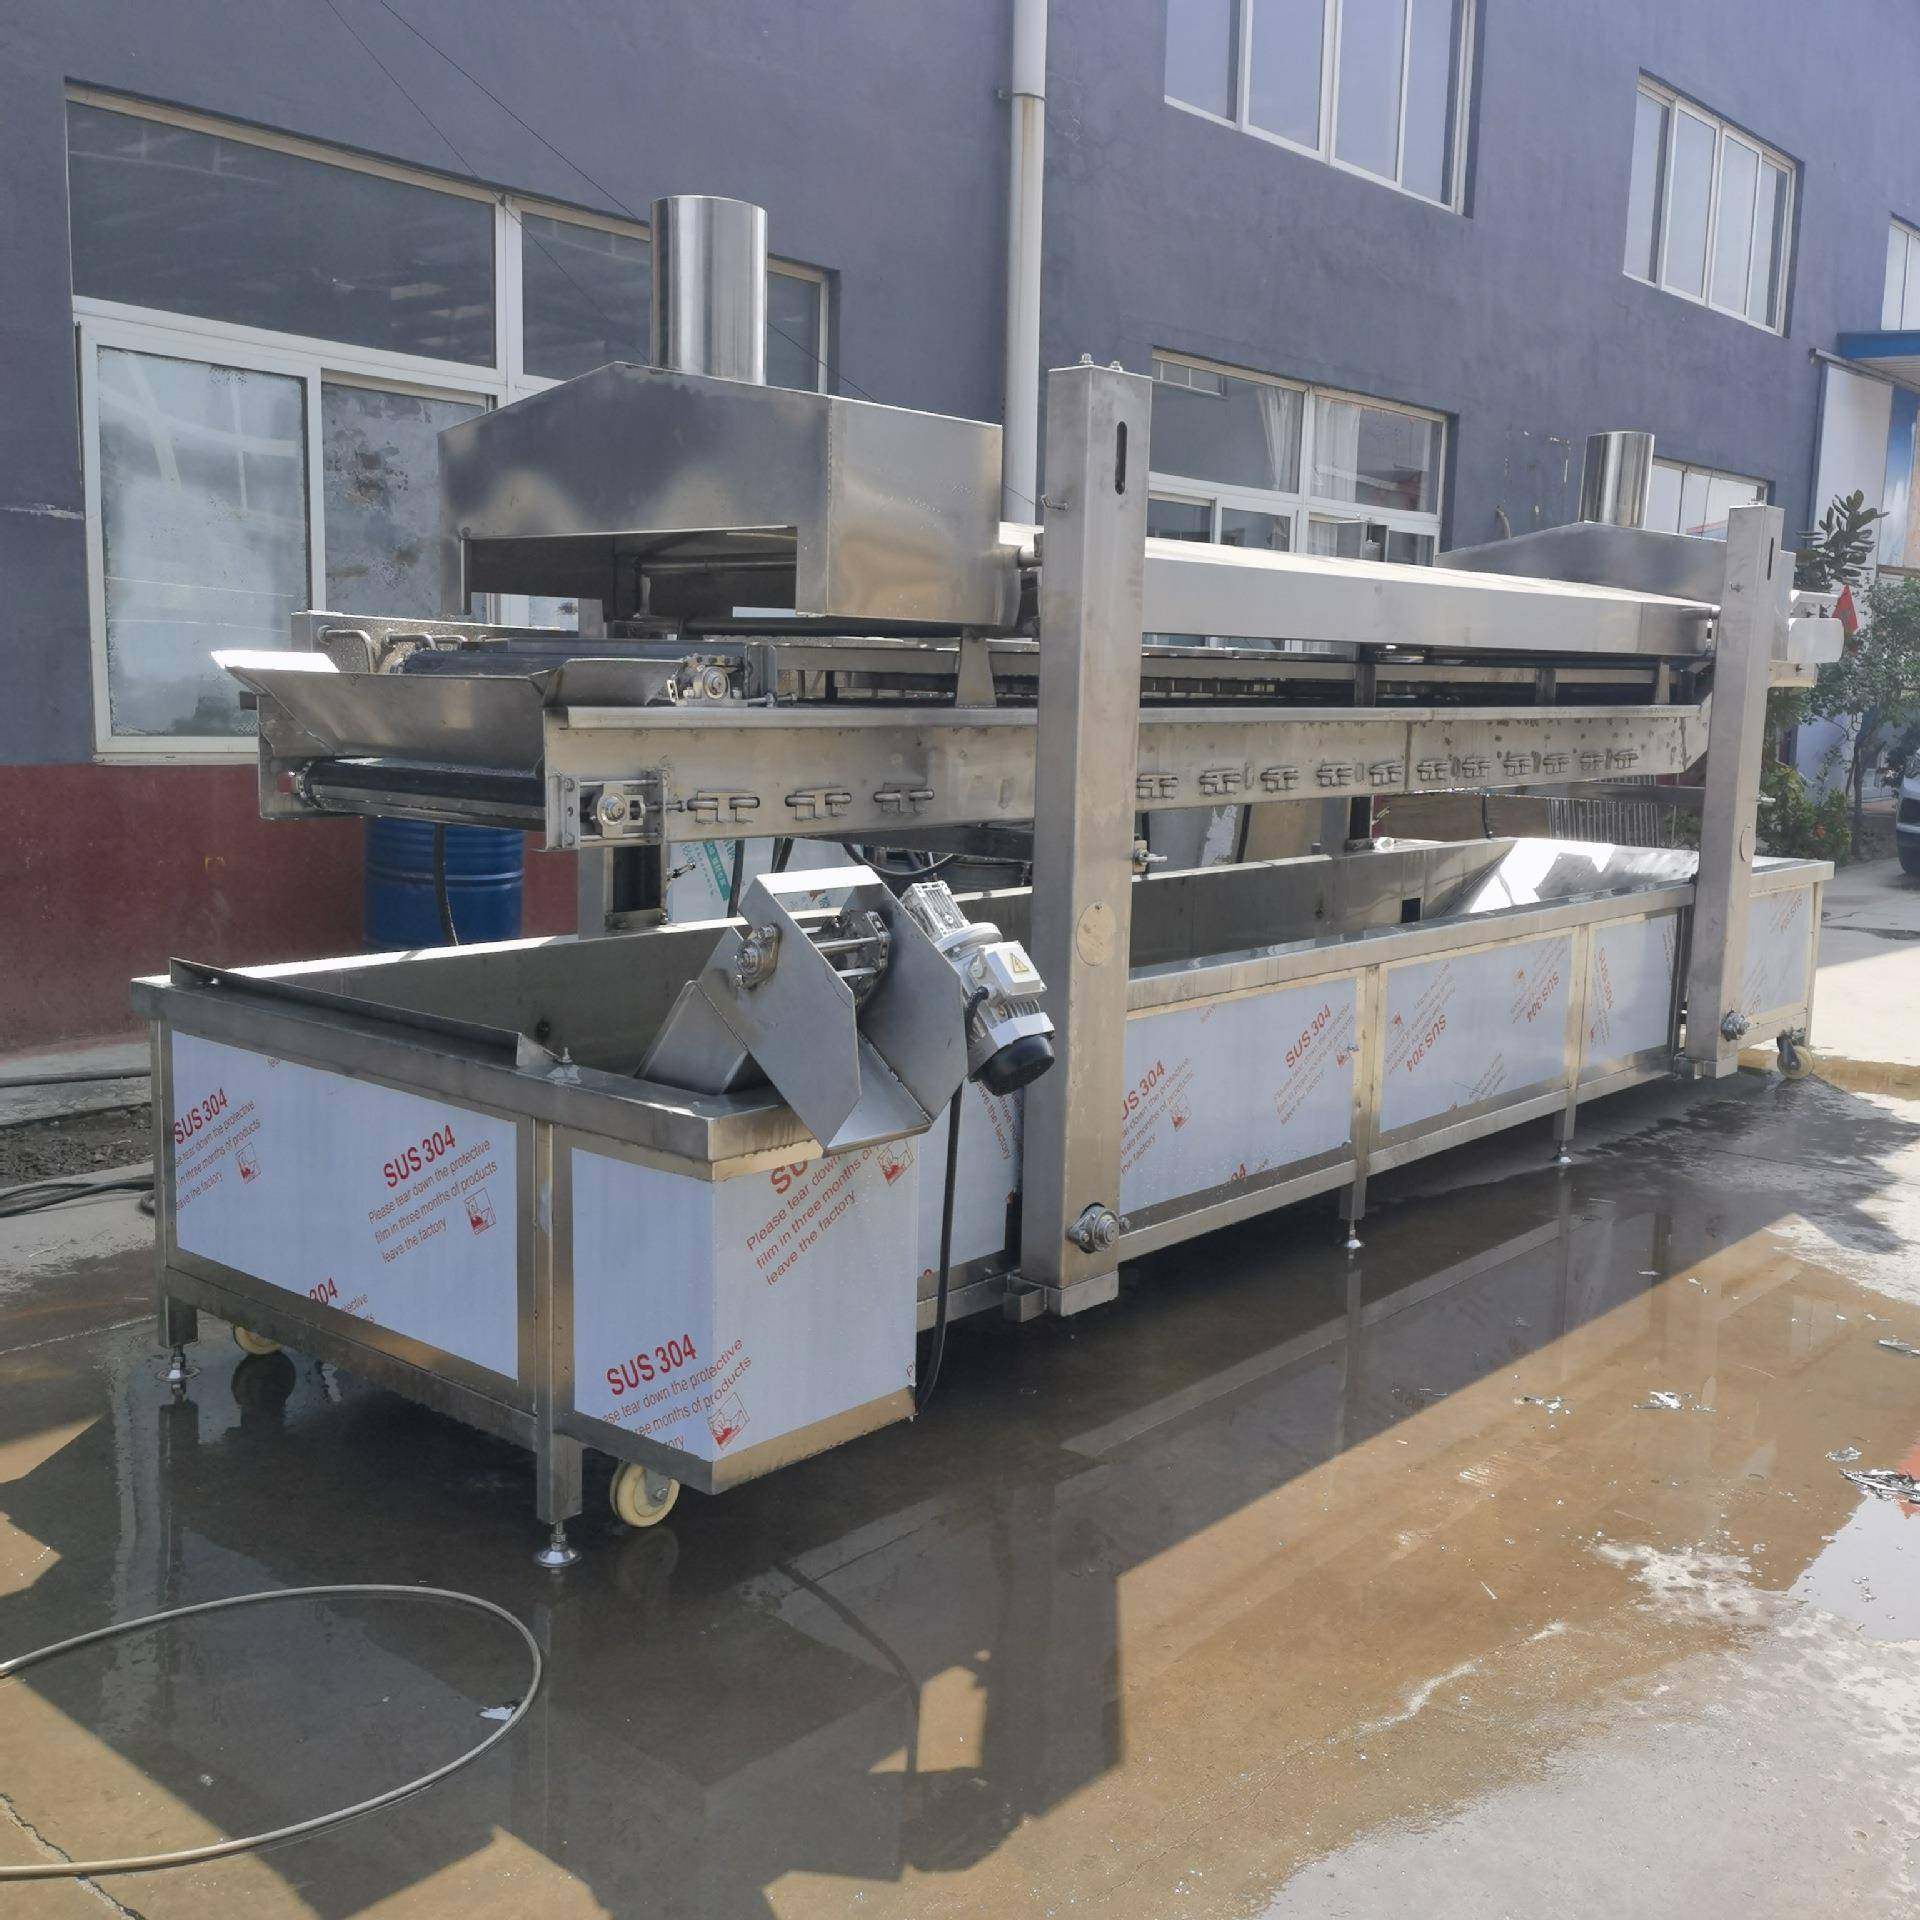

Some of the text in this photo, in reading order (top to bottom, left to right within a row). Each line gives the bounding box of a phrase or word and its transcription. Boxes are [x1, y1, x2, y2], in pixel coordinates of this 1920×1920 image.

[1285, 1030, 1311, 1068] SUS
[1311, 1004, 1331, 1036] 304
[1405, 1042, 1425, 1072] 304
[1424, 1014, 1447, 1048] SUS
[1139, 1059, 1164, 1097] 304
[173, 1088, 228, 1144] SUS 304
[233, 1119, 260, 1148] products
[368, 1140, 491, 1224] Please tear down the protective
[384, 1125, 455, 1188] SUS 304
[770, 1159, 808, 1195] SU
[375, 1229, 391, 1244] film
[398, 1210, 421, 1229] three
[421, 1191, 450, 1215] months
[451, 1184, 460, 1197] of
[461, 1161, 497, 1194] products
[746, 1208, 787, 1252] Please
[787, 1184, 810, 1210] tear
[756, 1244, 779, 1270] film
[779, 1232, 792, 1246] in
[791, 1200, 822, 1233] three
[822, 1158, 862, 1203] months
[382, 1217, 448, 1264] leave the factory
[765, 1190, 856, 1286] leave the factory
[606, 1334, 697, 1395] SUS 304
[621, 1399, 641, 1417] tear
[643, 1386, 671, 1408] down
[671, 1380, 689, 1395] the
[690, 1339, 743, 1390] protective
[652, 1406, 691, 1431] months
[691, 1396, 704, 1413] of
[702, 1357, 752, 1411] products
